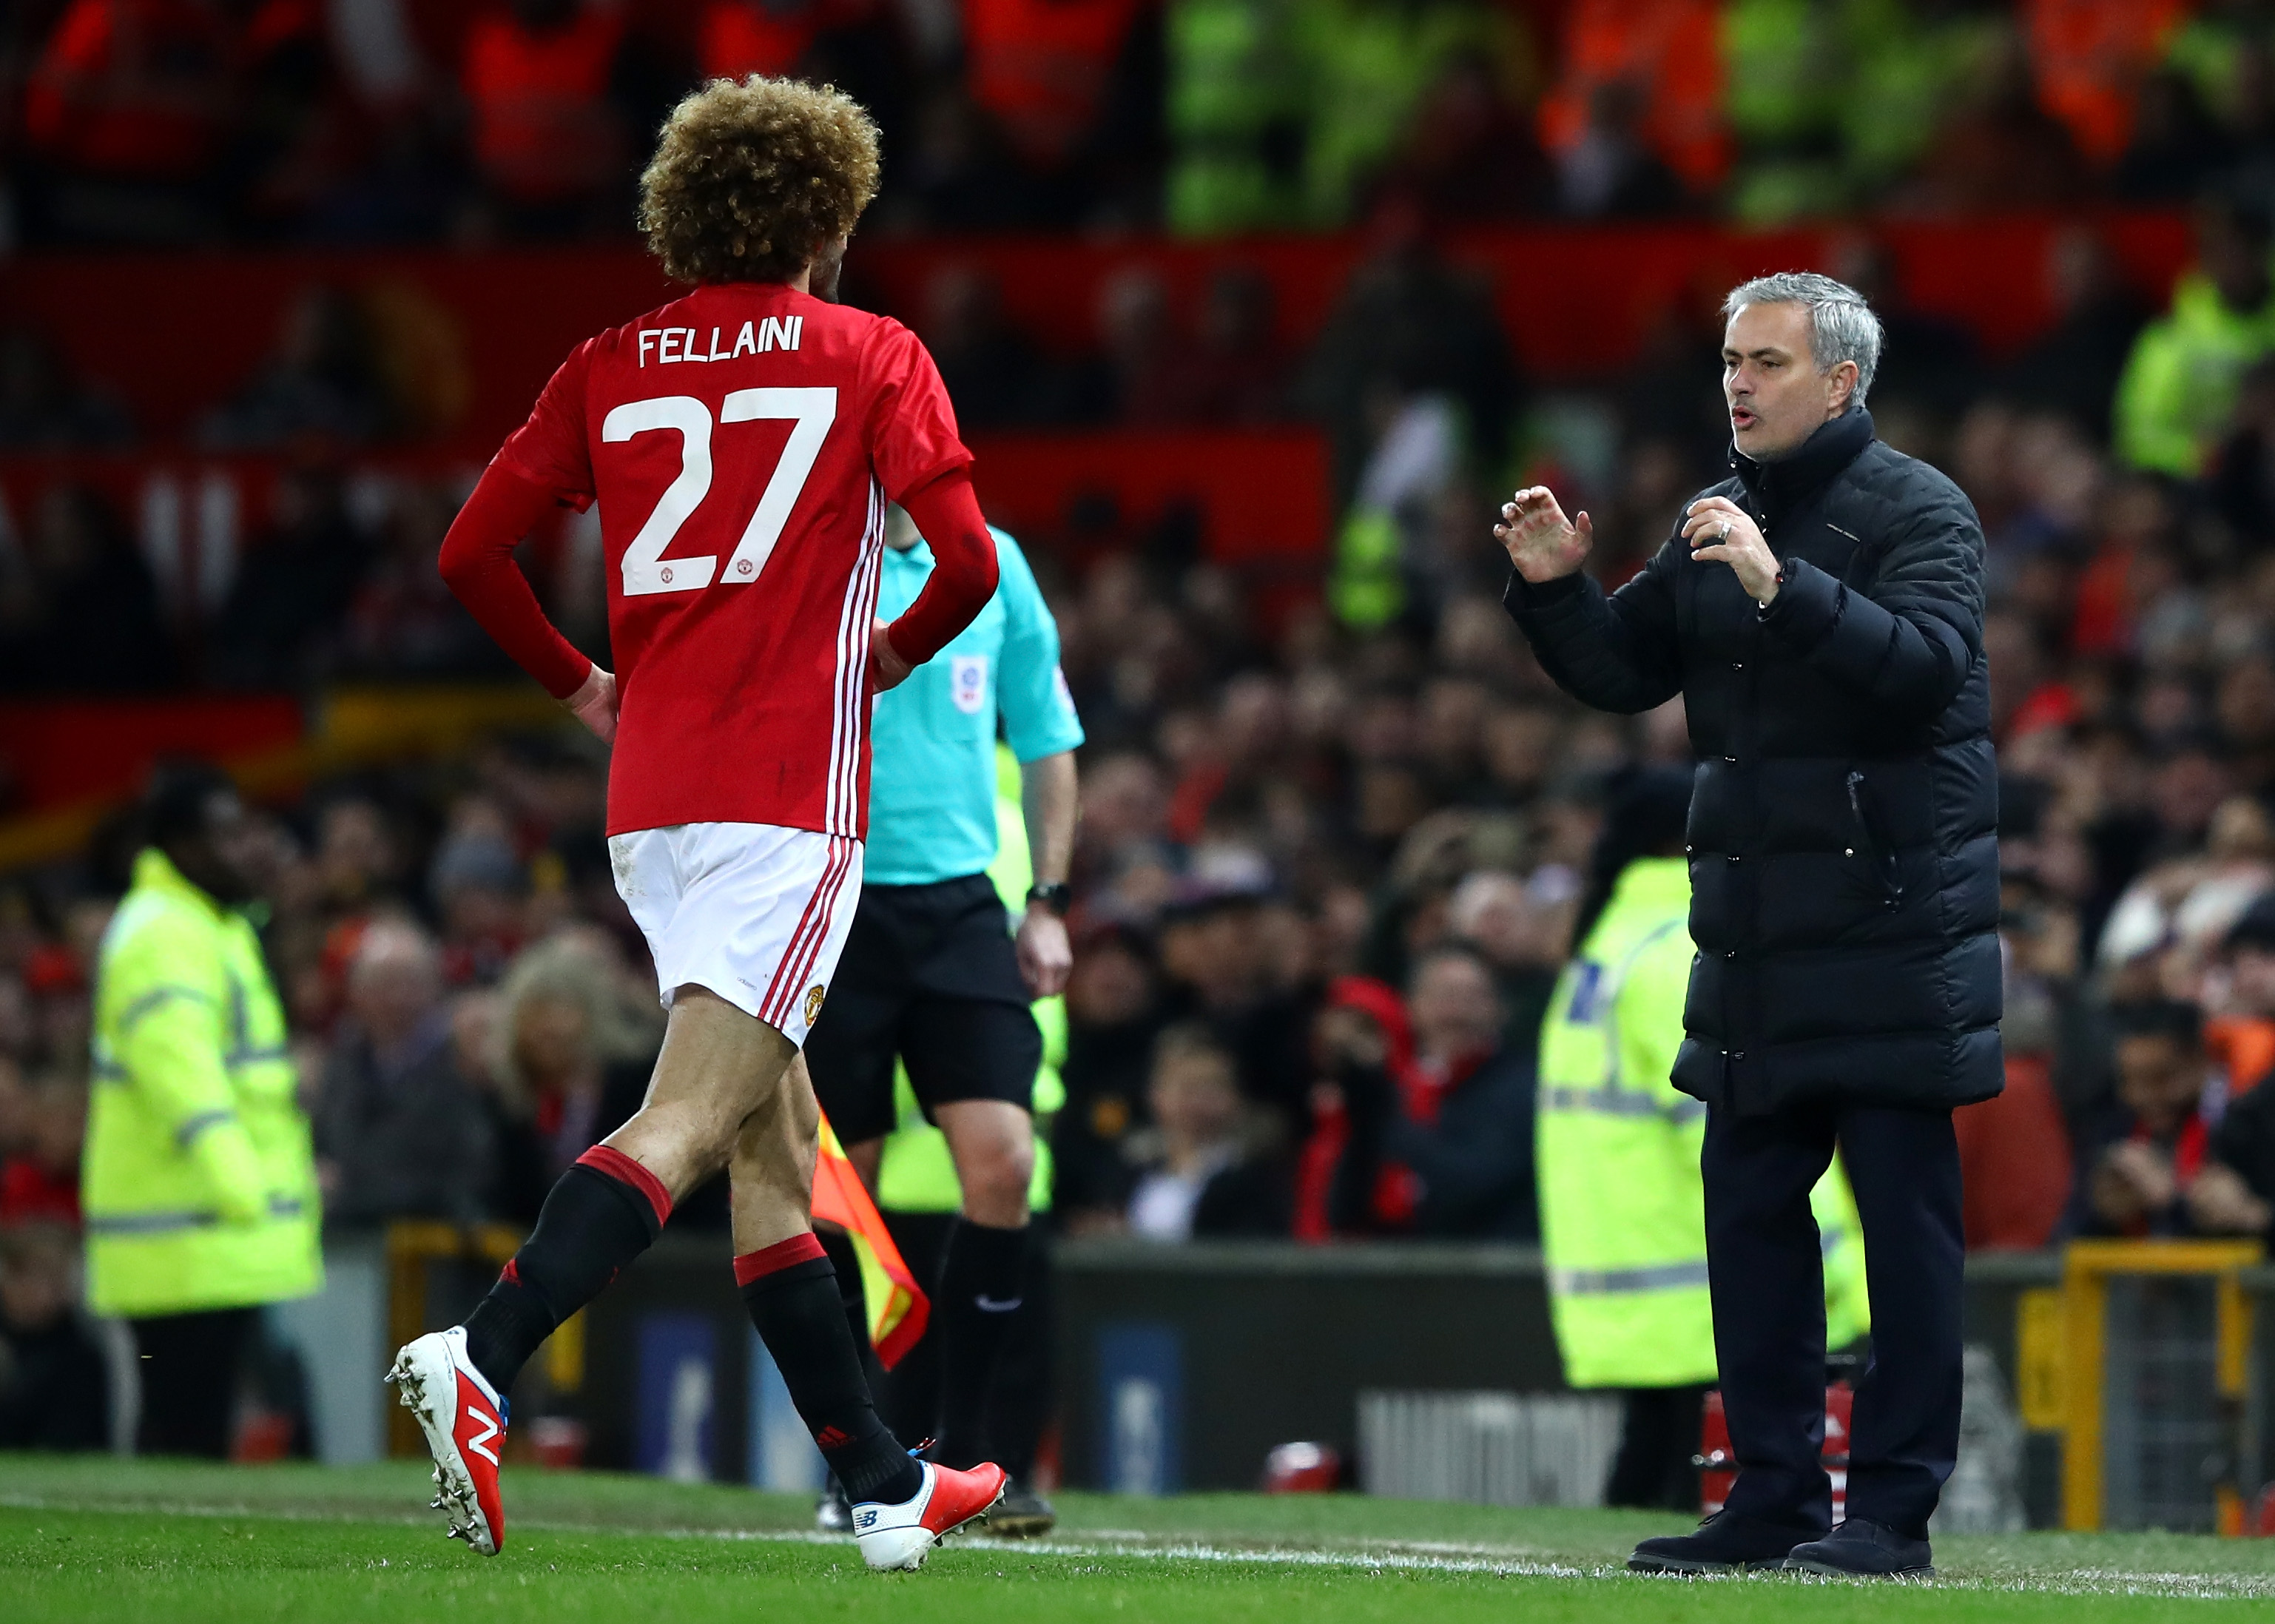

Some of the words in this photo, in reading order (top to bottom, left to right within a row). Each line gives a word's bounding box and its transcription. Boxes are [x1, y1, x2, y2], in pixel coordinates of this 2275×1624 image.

[638, 315, 803, 368] FELLAINI
[601, 387, 837, 596] 27
[468, 1405, 499, 1467] N
